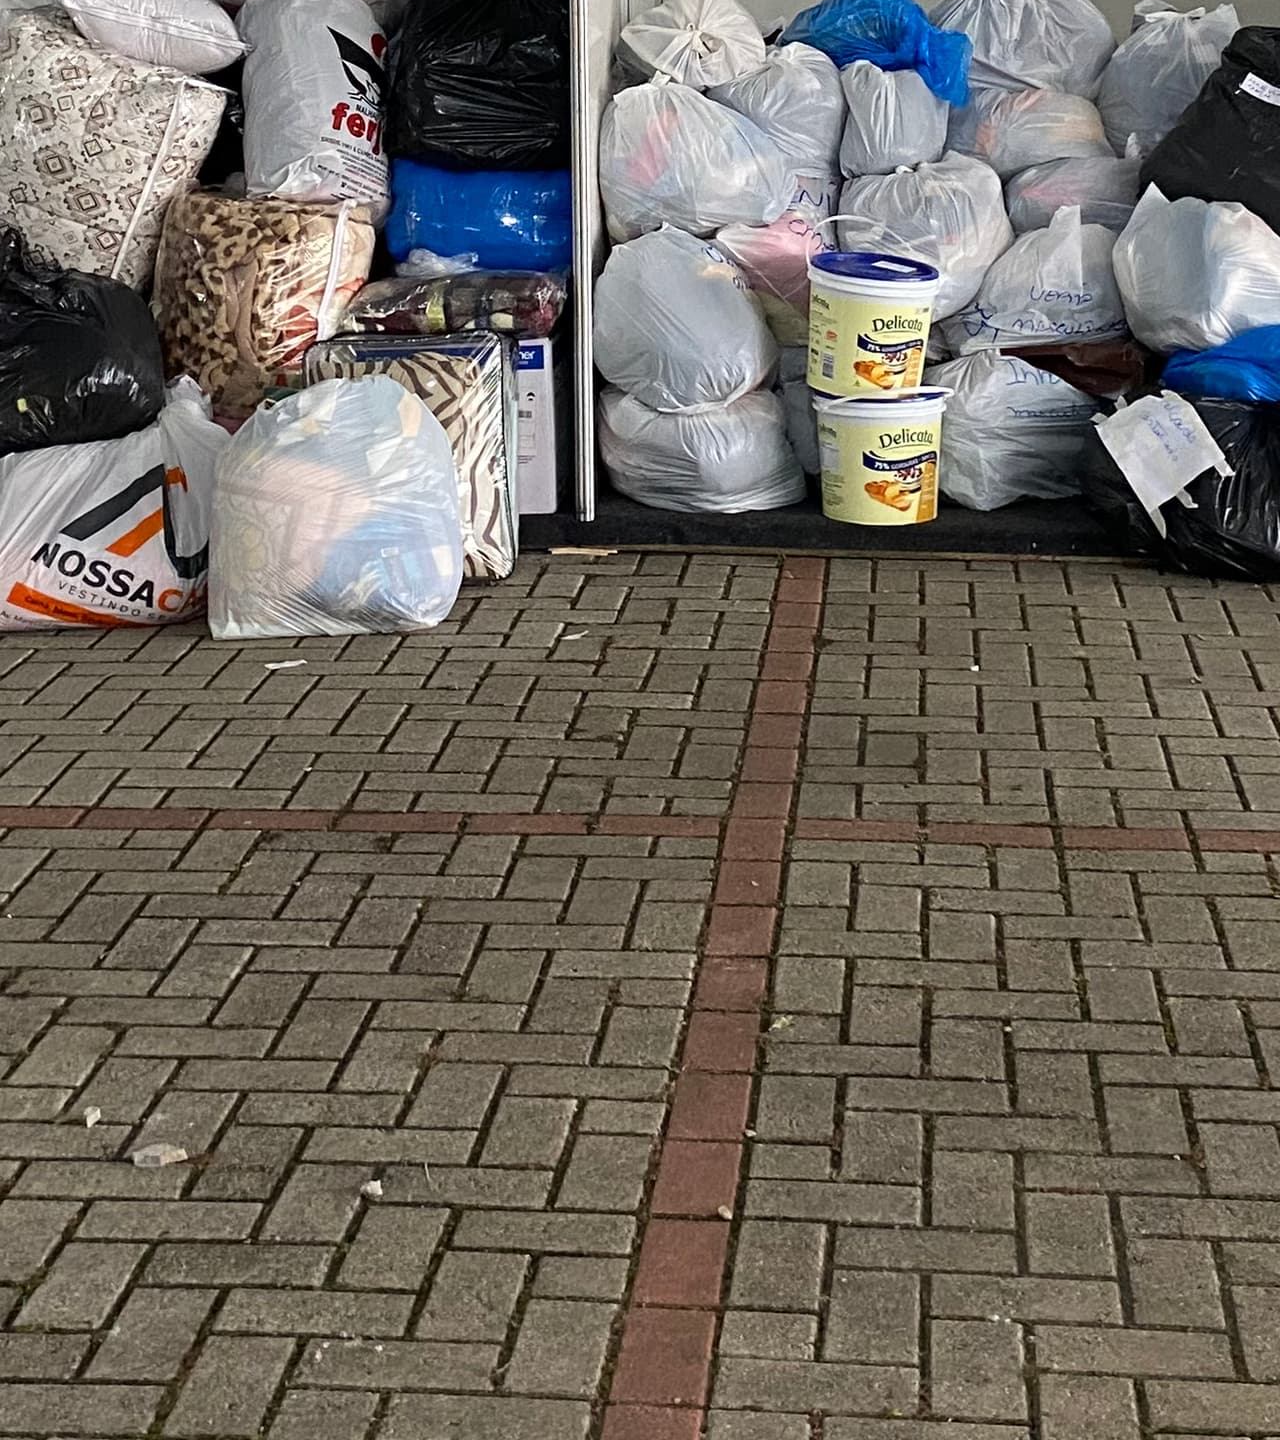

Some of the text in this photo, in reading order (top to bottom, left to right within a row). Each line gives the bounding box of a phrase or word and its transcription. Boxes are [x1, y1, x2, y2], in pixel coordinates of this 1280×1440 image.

[871, 315, 924, 333] Delicata
[878, 428, 934, 449] Delicata
[58, 579, 142, 618] VESTINDO
